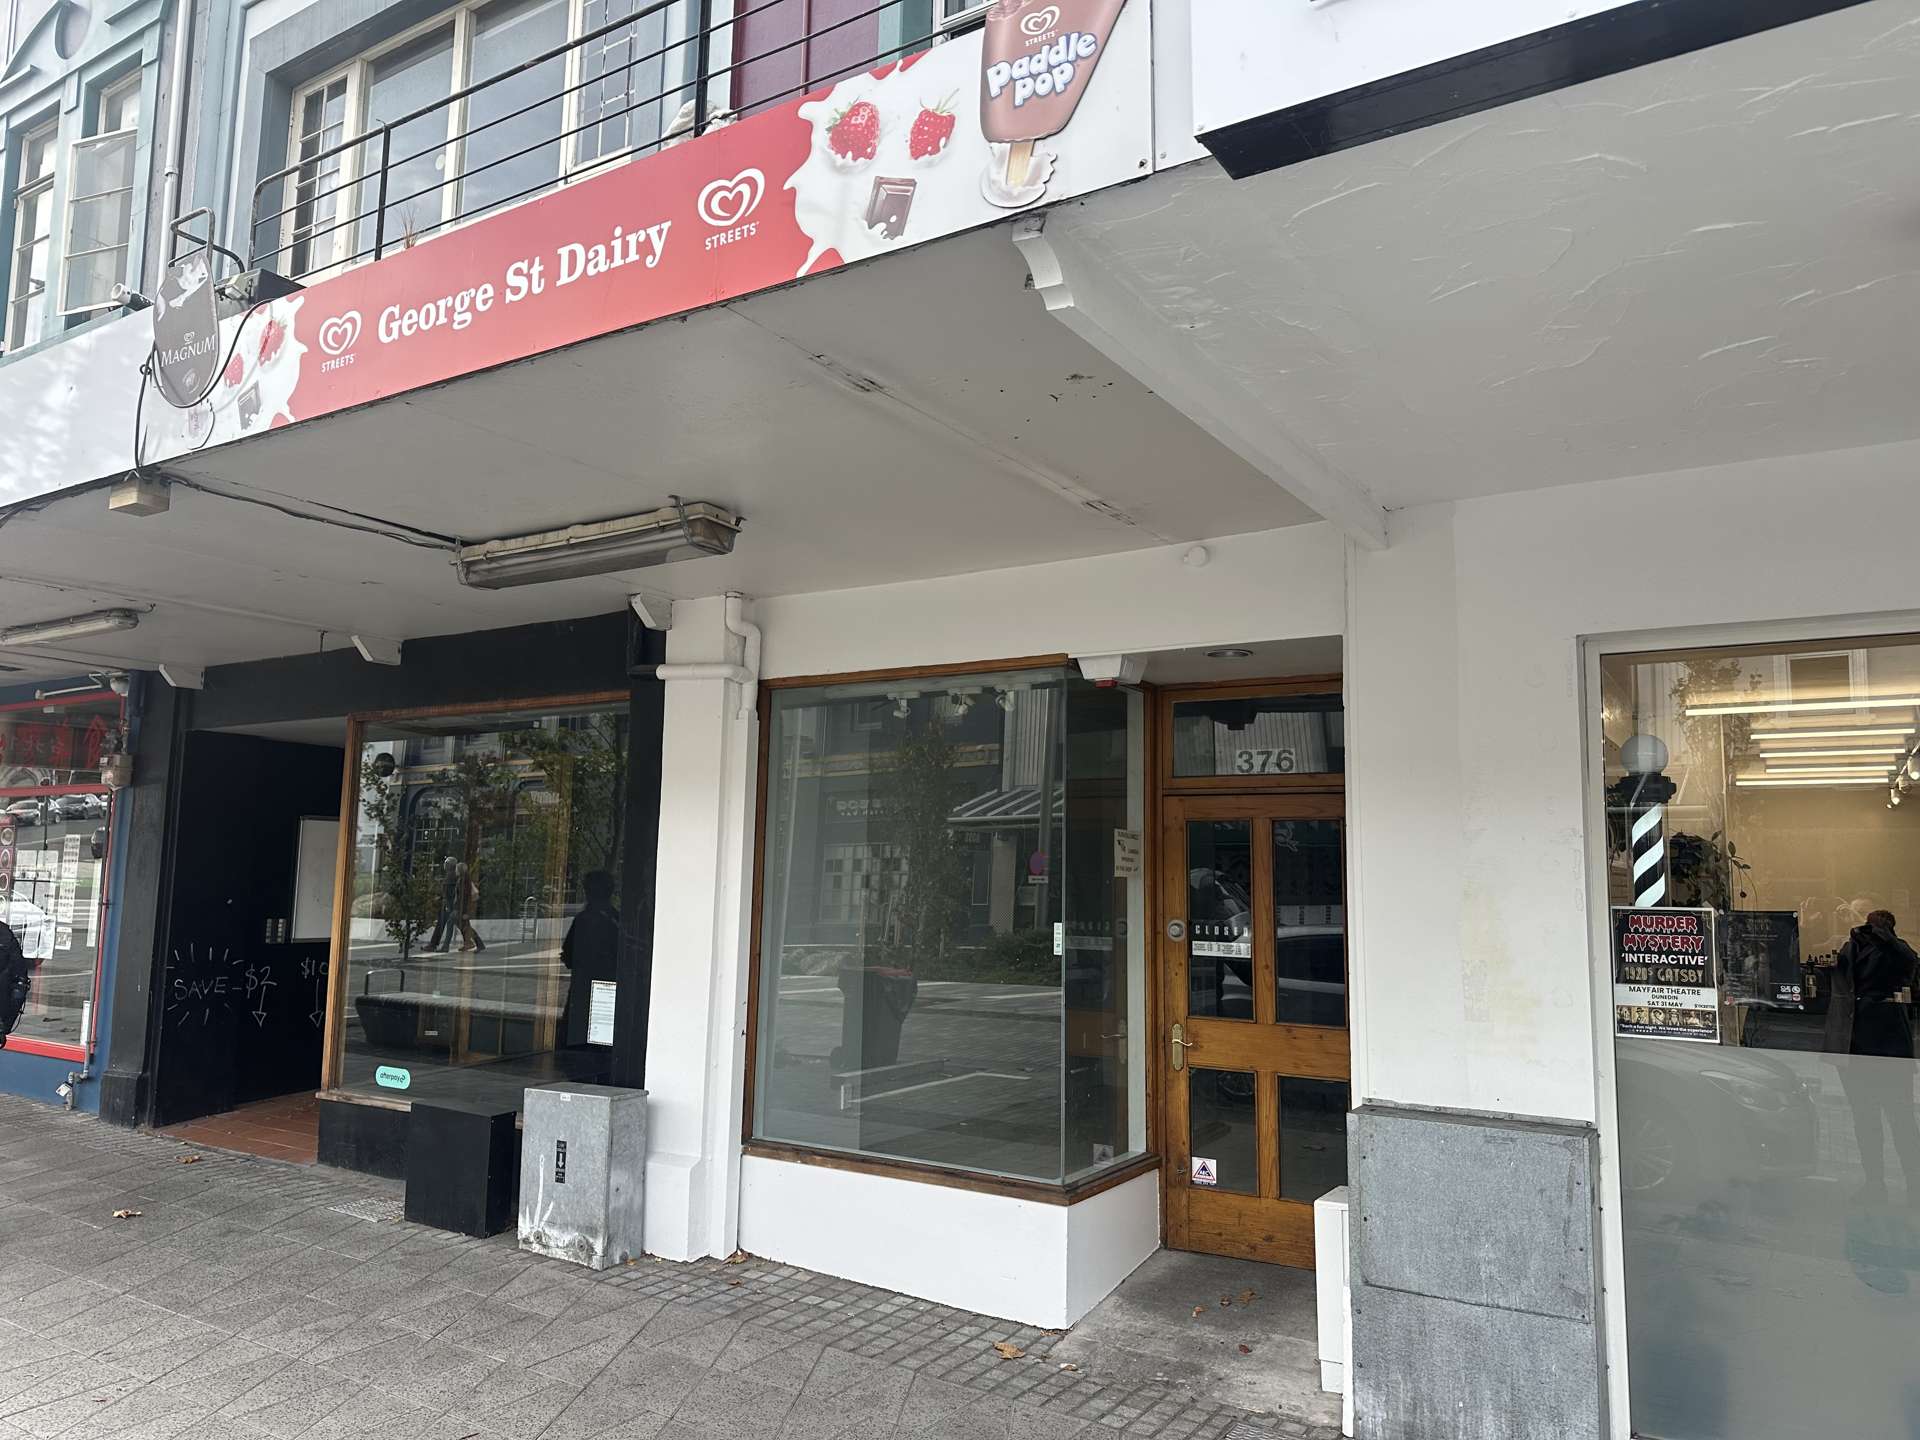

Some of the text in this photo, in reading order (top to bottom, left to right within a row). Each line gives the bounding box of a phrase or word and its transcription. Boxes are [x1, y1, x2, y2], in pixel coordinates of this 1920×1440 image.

[1024, 29, 1056, 47] STREETS
[705, 221, 758, 250] STREETS
[377, 220, 672, 344] George St Dairy
[160, 334, 216, 368] MAGNUM
[321, 353, 355, 373] STREETS
[1237, 749, 1294, 773] 376
[1195, 924, 1248, 937] CLOSED
[1629, 915, 1697, 934] MURDER
[1623, 934, 1704, 953] MYSTERY
[1657, 967, 1704, 983] GATSBY
[174, 976, 230, 1000] SAVE
[1628, 986, 1702, 996] MAYFAIR THEATRE
[1651, 993, 1678, 1001] DUNEDIN
